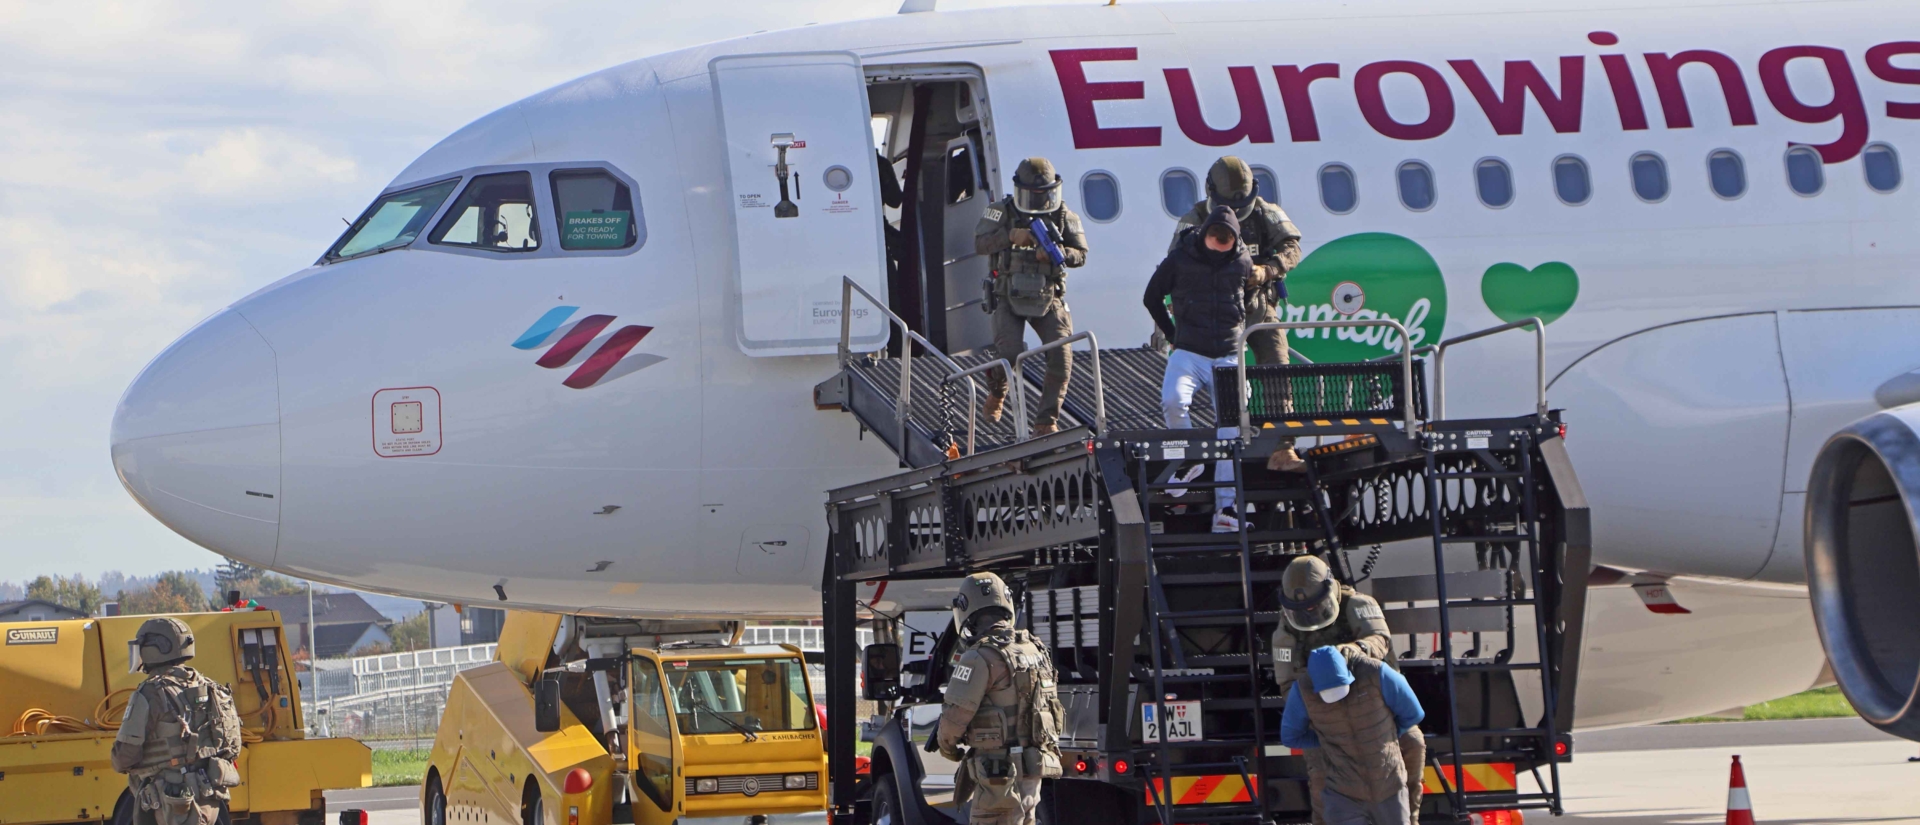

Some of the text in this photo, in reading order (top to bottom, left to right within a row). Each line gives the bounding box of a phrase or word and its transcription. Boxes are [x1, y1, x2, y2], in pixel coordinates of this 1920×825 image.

[1048, 31, 1920, 164] Eurowings
[569, 217, 603, 225] BRAKES
[812, 307, 869, 319] Eurongs
[1646, 589, 1665, 598] HOT
[1164, 705, 1175, 721] W
[1168, 721, 1196, 738] AJL
